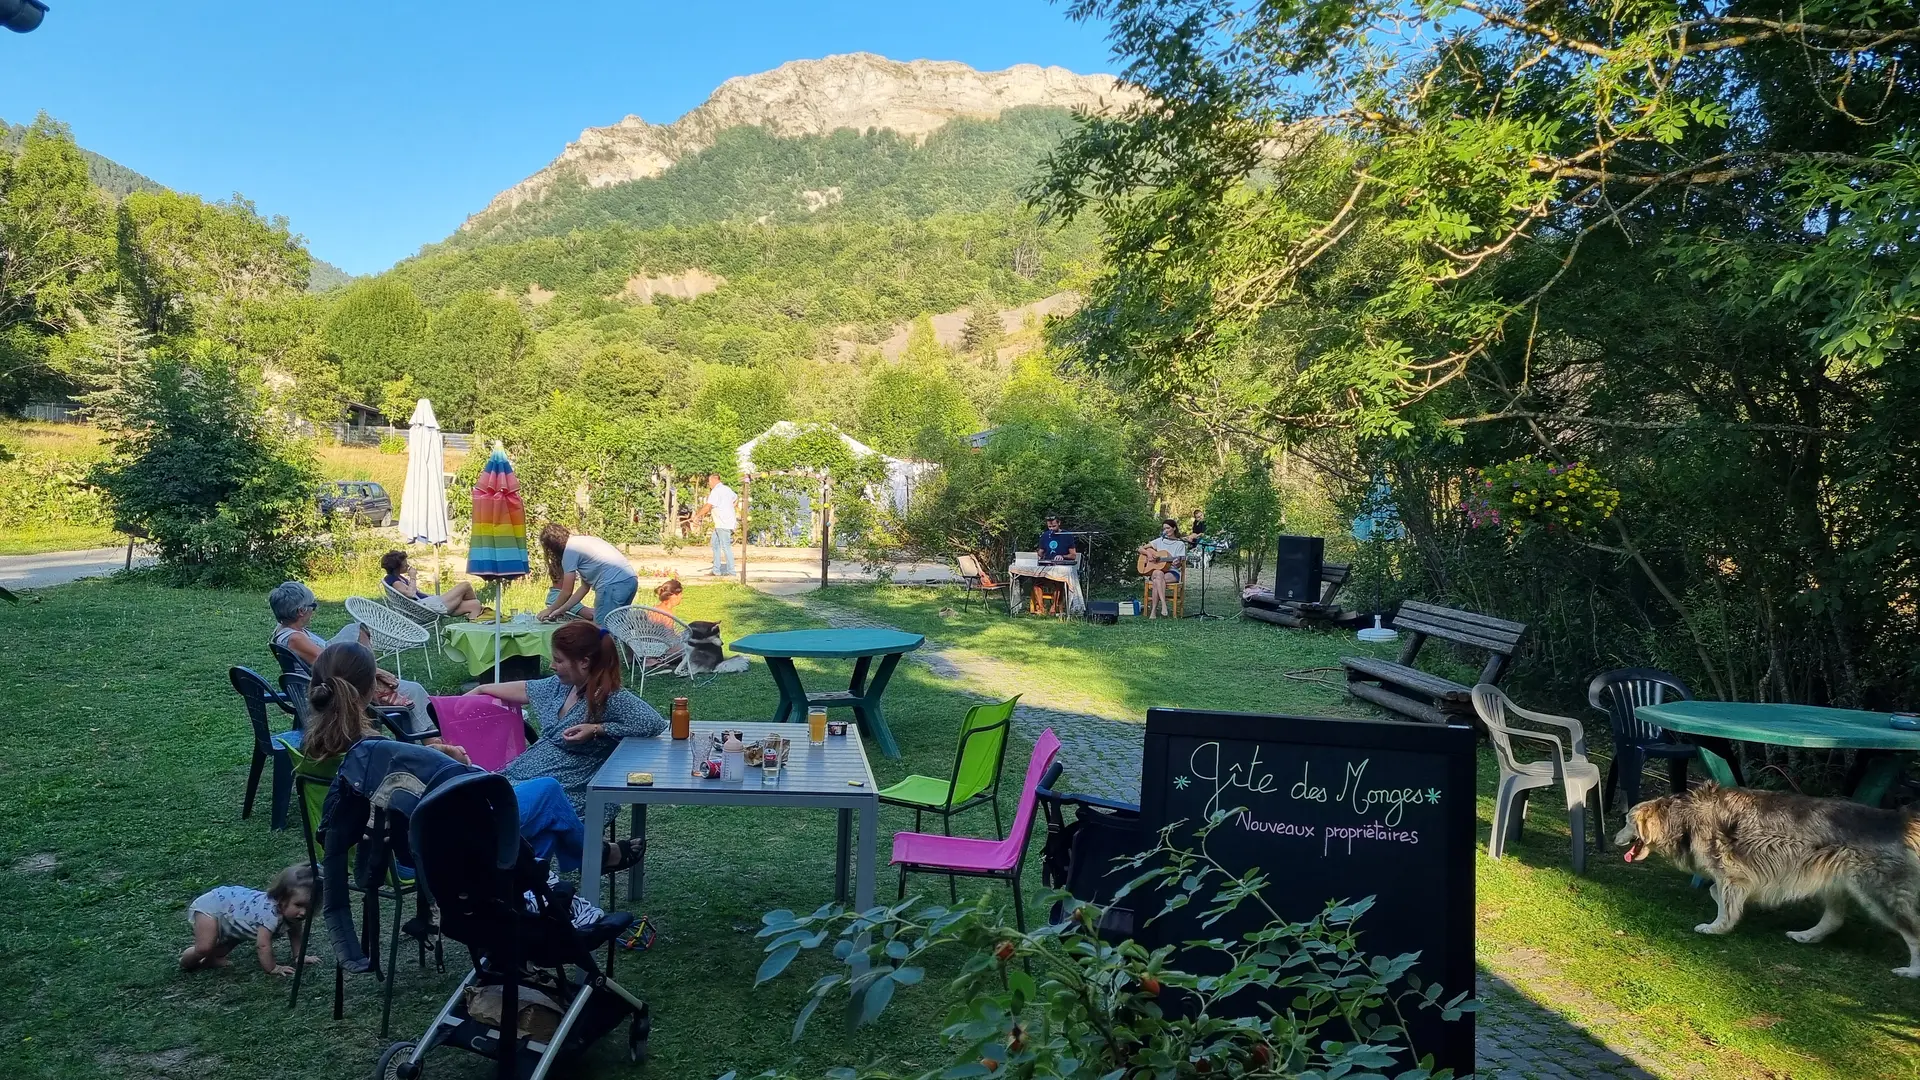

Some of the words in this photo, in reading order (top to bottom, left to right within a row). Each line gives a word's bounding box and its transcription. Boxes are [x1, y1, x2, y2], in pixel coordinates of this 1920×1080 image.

[1290, 760, 1328, 803] des
[1336, 758, 1423, 827] Monges
[1235, 811, 1315, 838] Nouveaux
[1324, 820, 1419, 857] propriétaires
